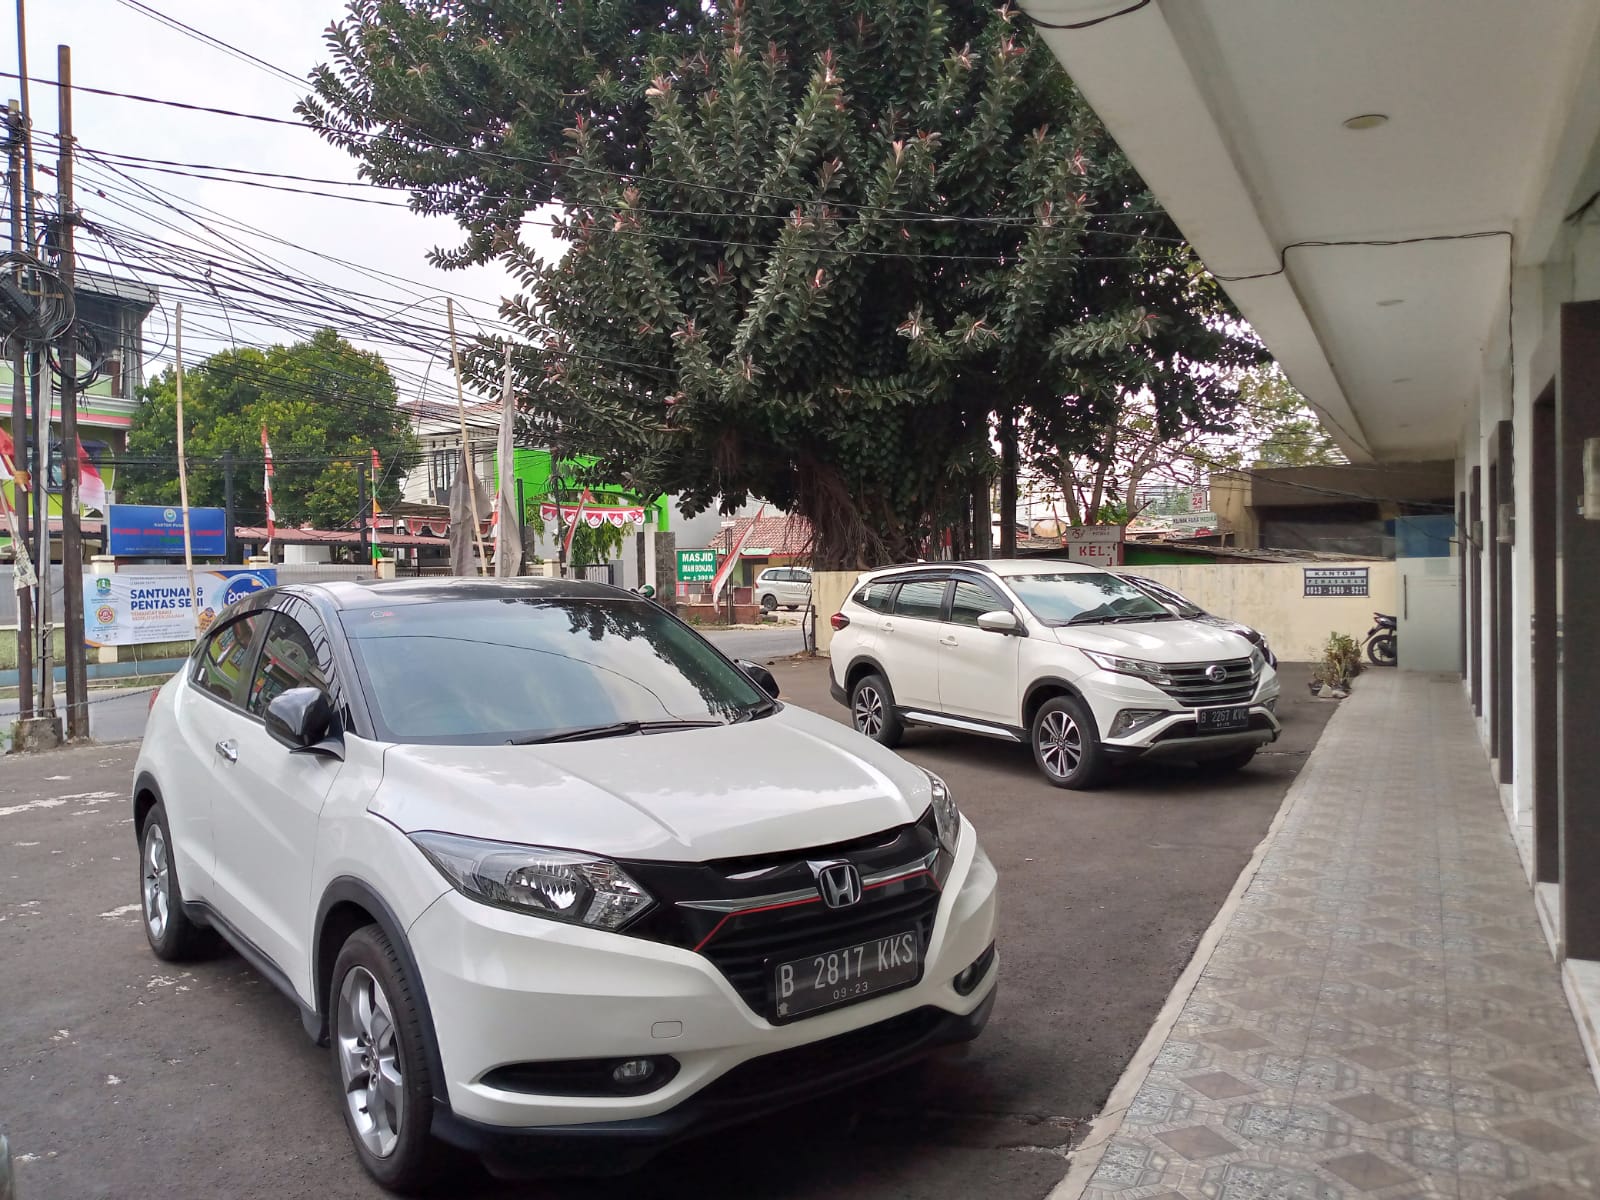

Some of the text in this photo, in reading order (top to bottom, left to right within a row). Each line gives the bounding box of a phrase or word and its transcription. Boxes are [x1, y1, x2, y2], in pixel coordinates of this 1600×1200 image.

[1192, 497, 1203, 505] 24
[682, 552, 714, 562] MASJID
[682, 564, 714, 573] IMAM BONJOL
[196, 586, 204, 597] &
[130, 599, 176, 611] PENTAS
[178, 597, 204, 608] SEI
[1200, 711, 1207, 723] B
[780, 934, 914, 998] B 2817 KKS
